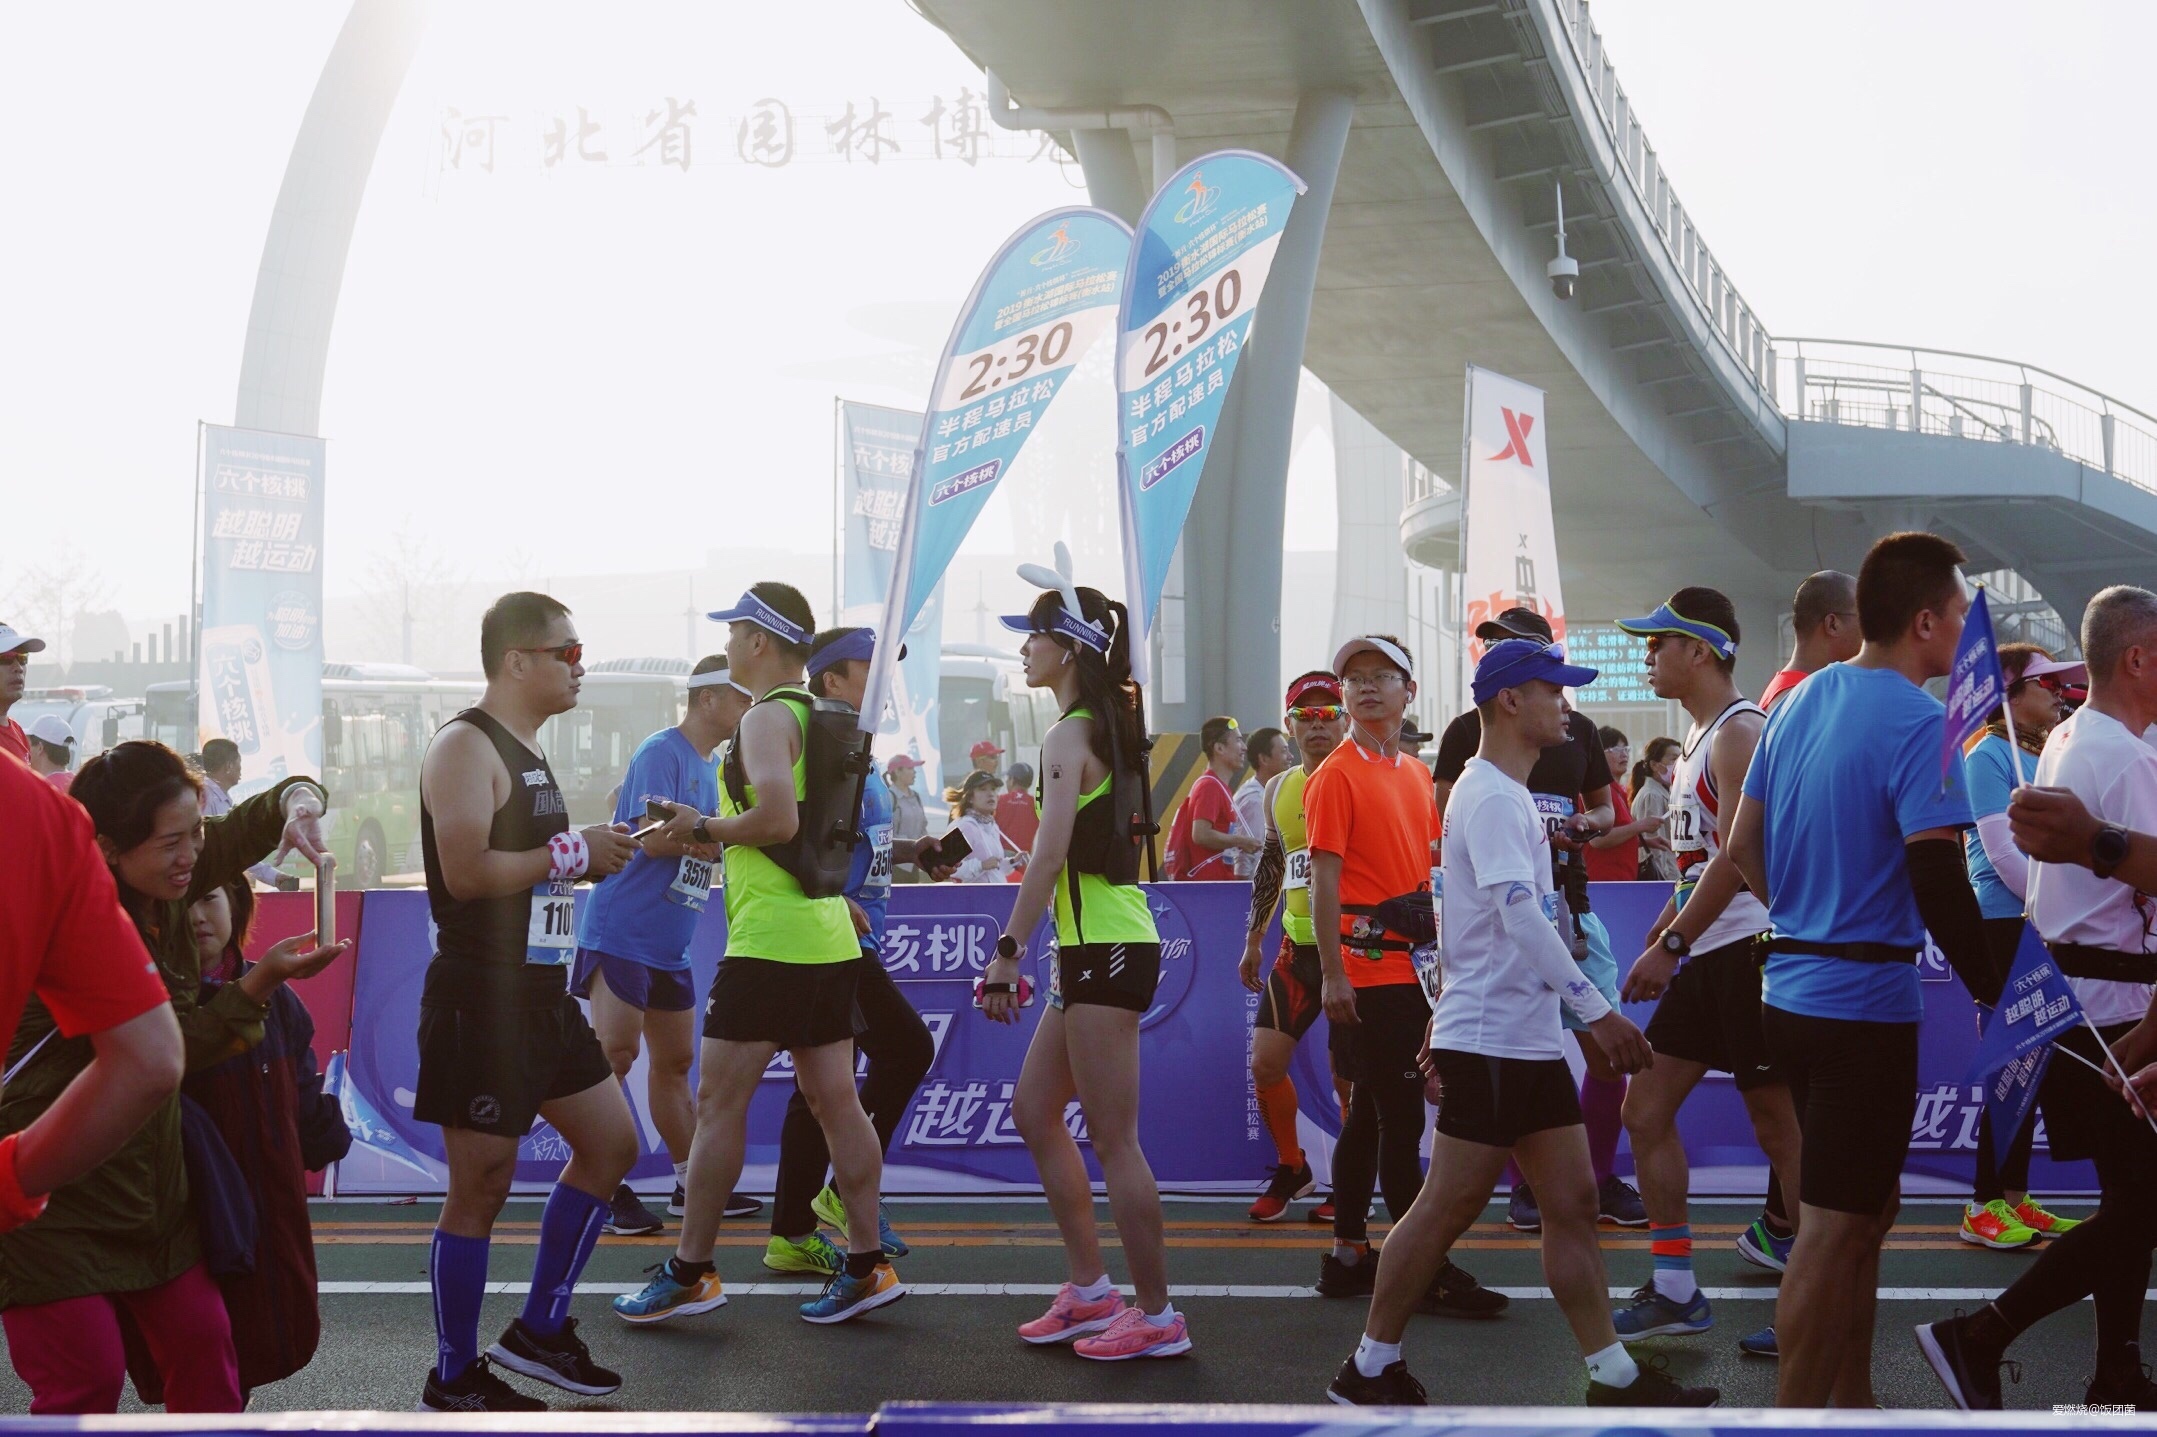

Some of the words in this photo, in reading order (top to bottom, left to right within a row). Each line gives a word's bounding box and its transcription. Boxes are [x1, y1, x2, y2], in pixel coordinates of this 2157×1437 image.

[1143, 269, 1242, 378] 2:30
[959, 321, 1073, 401] 2:30
[1130, 329, 1238, 419] 半程马拉松
[938, 379, 1054, 439] 半程马拉松
[1131, 369, 1224, 448] 官方配速员
[932, 411, 1032, 464] 官方配速员
[854, 446, 914, 476] 六个核
[1145, 433, 1201, 485] 六个核桃
[218, 468, 306, 500] 六个核桃
[935, 466, 998, 502] 六个核桃
[212, 509, 302, 542] 越聪明
[229, 540, 318, 573] 越运动
[755, 608, 790, 634] RUNNING
[1063, 617, 1099, 643] RUNNING
[212, 652, 254, 744] 六个核桃
[2016, 965, 2051, 992] 六个核桃
[2004, 988, 2046, 1026] 越聪明
[2033, 994, 2071, 1028] 越运动
